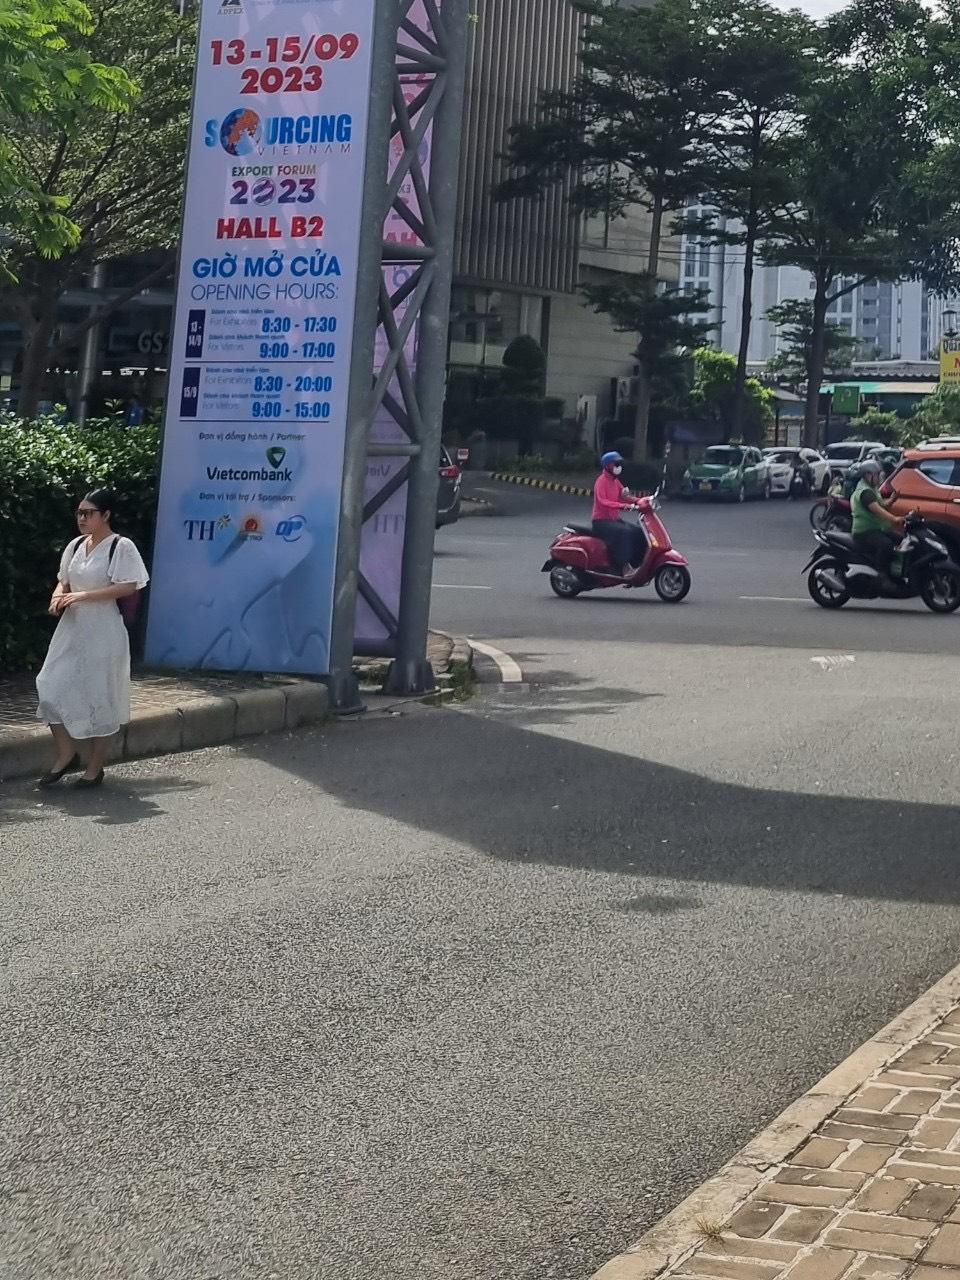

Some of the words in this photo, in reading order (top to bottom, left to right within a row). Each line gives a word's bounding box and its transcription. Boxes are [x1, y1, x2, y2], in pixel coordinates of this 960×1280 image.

[211, 33, 359, 65] 13-15/09
[240, 65, 323, 94] 2023
[258, 144, 351, 156] VIETNAM
[232, 165, 273, 177] EXPORT
[277, 164, 316, 176] FORUM
[230, 177, 316, 206] 2023
[216, 216, 282, 239] HALL
[291, 215, 324, 238] B2
[192, 252, 238, 278] GIỜ
[244, 250, 284, 277] MỞ
[290, 249, 341, 277] CỬA
[191, 283, 270, 301] OPENING
[275, 282, 339, 300] HOURS:
[262, 317, 291, 333] 8:30
[304, 316, 337, 332] 17:30
[260, 342, 289, 358] 9:00
[302, 342, 335, 358] 17:00
[254, 376, 283, 392] 8:30
[294, 376, 332, 392] 20:00
[252, 401, 281, 418] 9:00
[295, 402, 330, 418] 15:00
[207, 466, 292, 481] Vietcombank
[184, 520, 216, 540] TH
